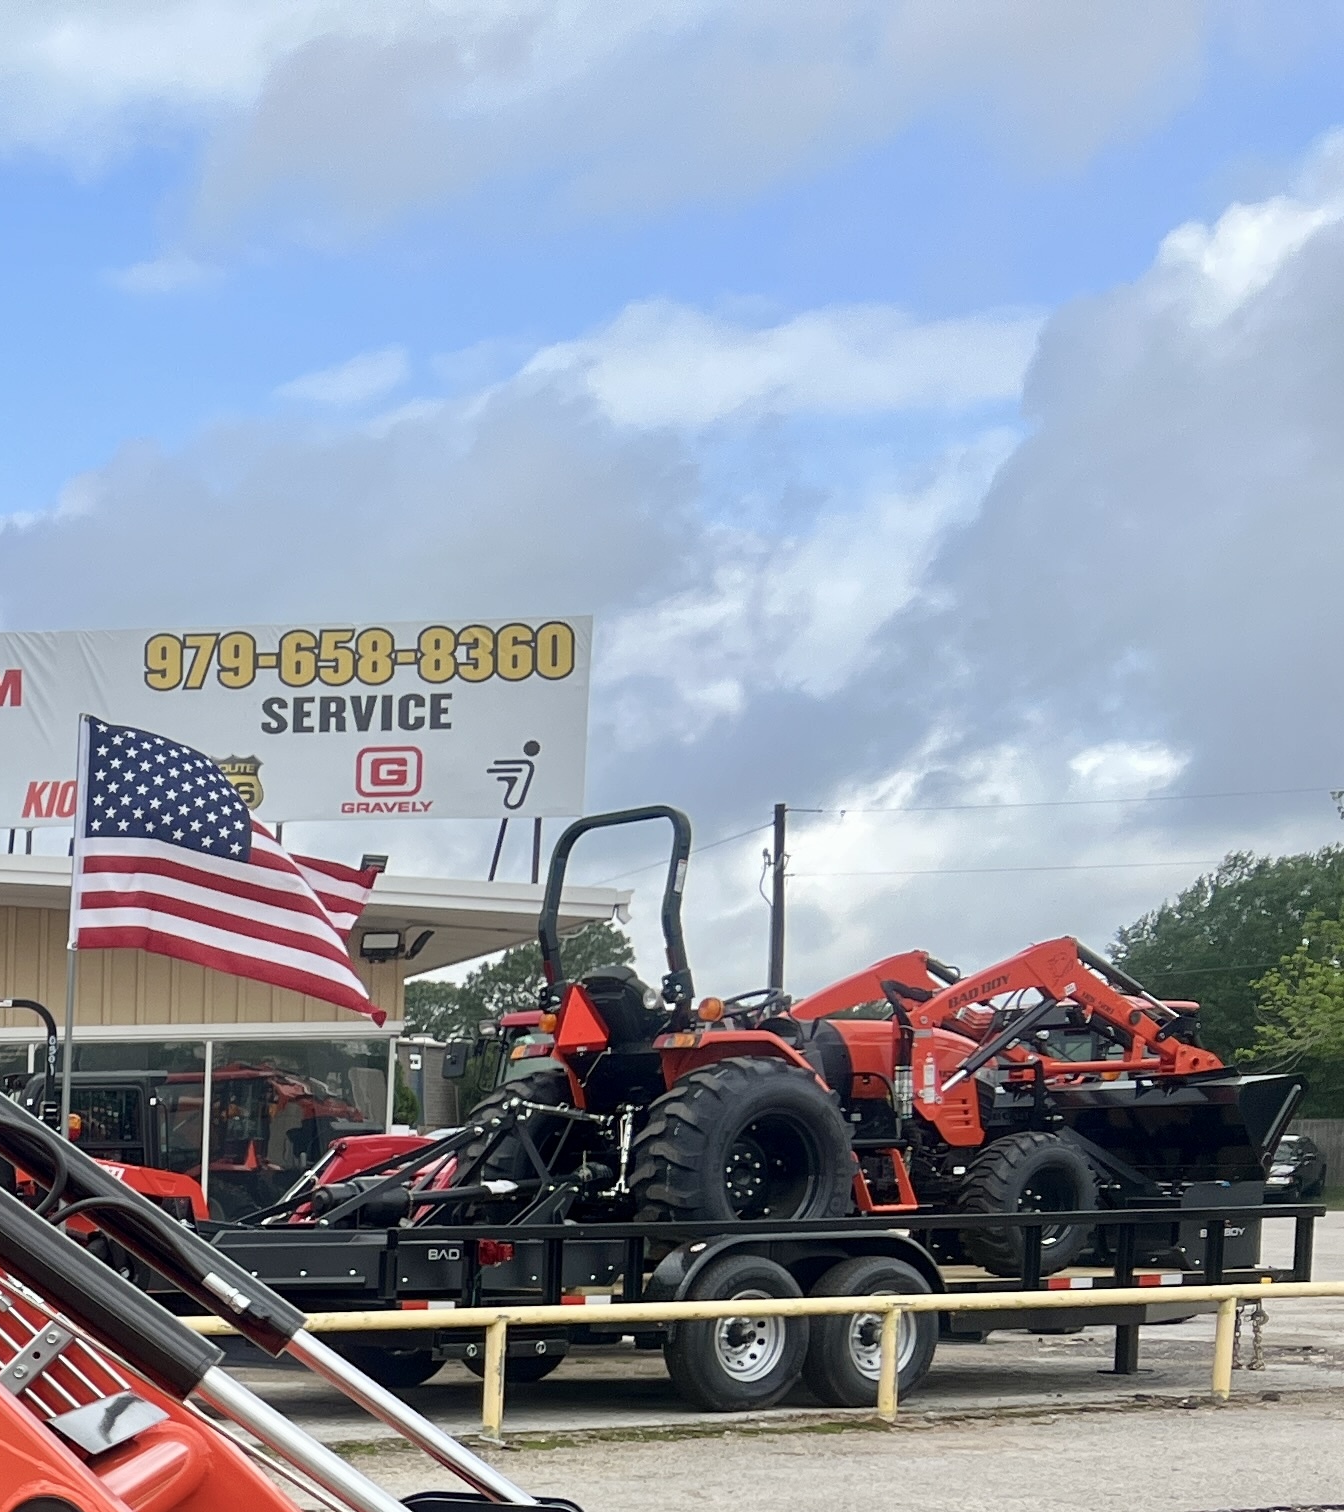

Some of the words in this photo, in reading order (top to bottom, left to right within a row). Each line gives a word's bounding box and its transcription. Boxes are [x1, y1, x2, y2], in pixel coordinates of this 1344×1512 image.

[144, 621, 575, 691] 979-658-8360
[261, 693, 453, 734] SERVICE
[341, 801, 434, 814] GRAVELY
[428, 1248, 460, 1260] BAD
